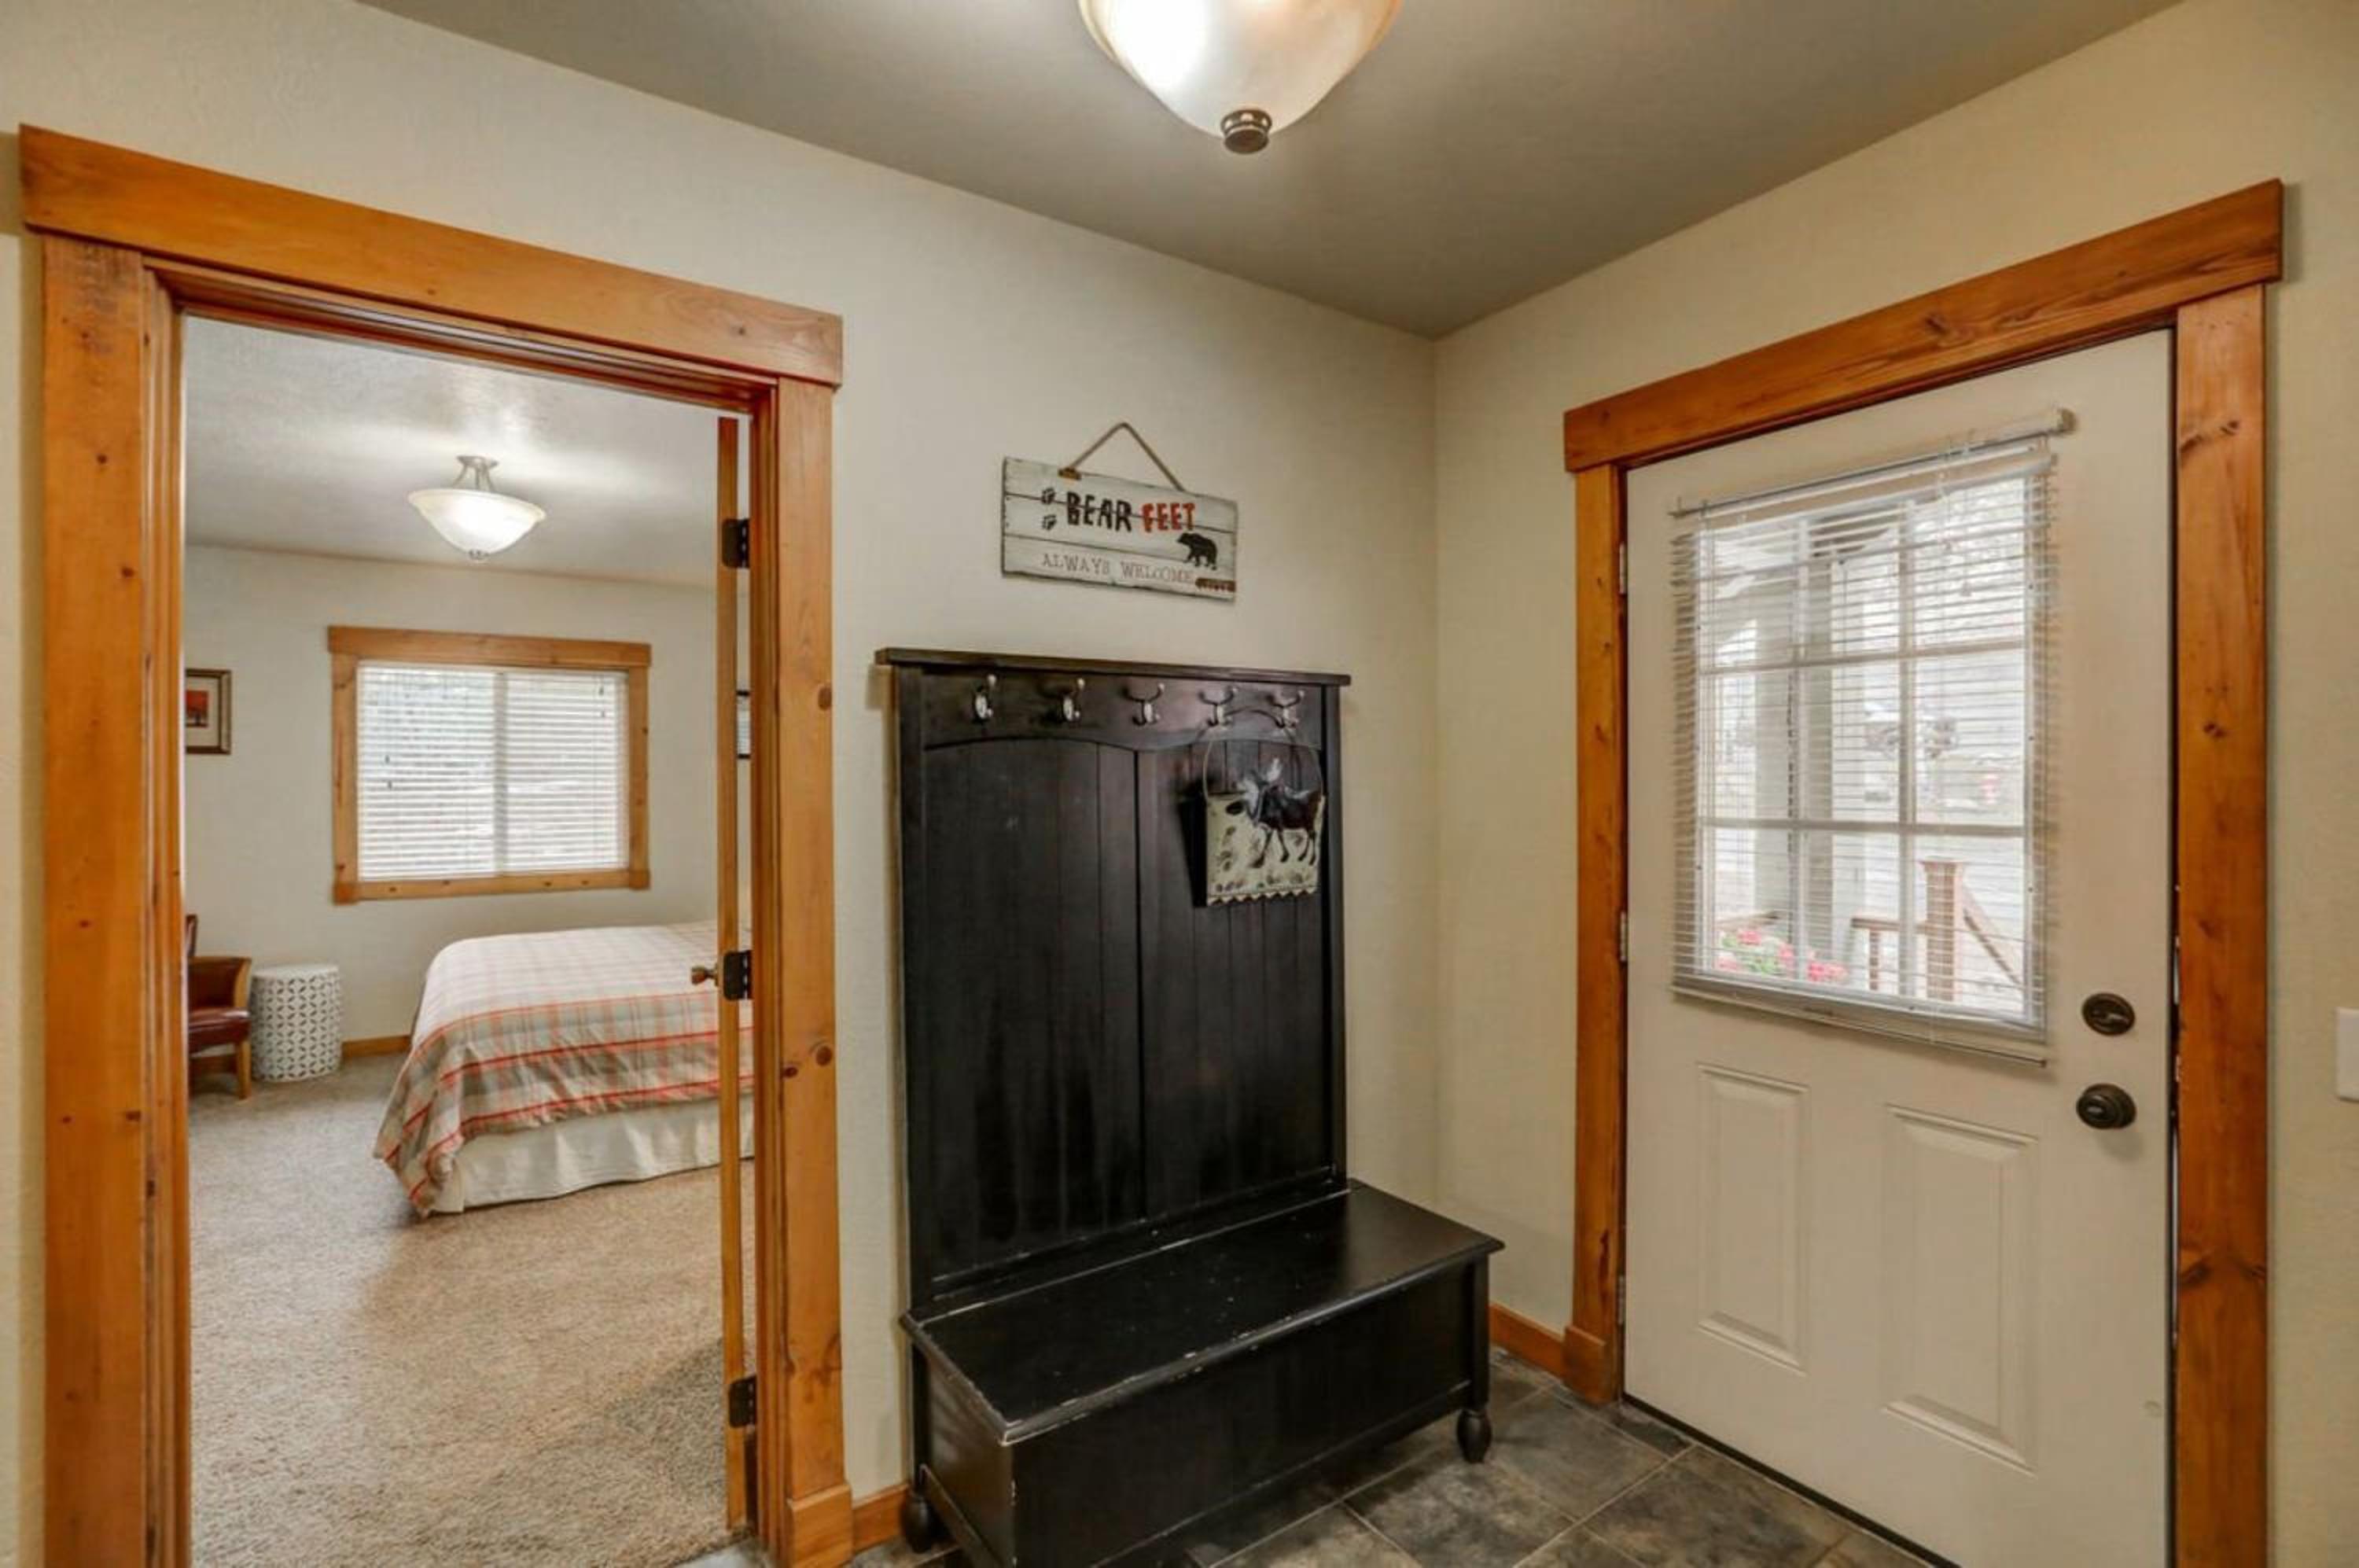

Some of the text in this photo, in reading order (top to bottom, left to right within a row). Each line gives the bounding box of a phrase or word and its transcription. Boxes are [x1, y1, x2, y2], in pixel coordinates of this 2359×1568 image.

[1066, 491, 1196, 532] BEAR FEET
[1043, 553, 1195, 584] ALWAYS WELCOME
